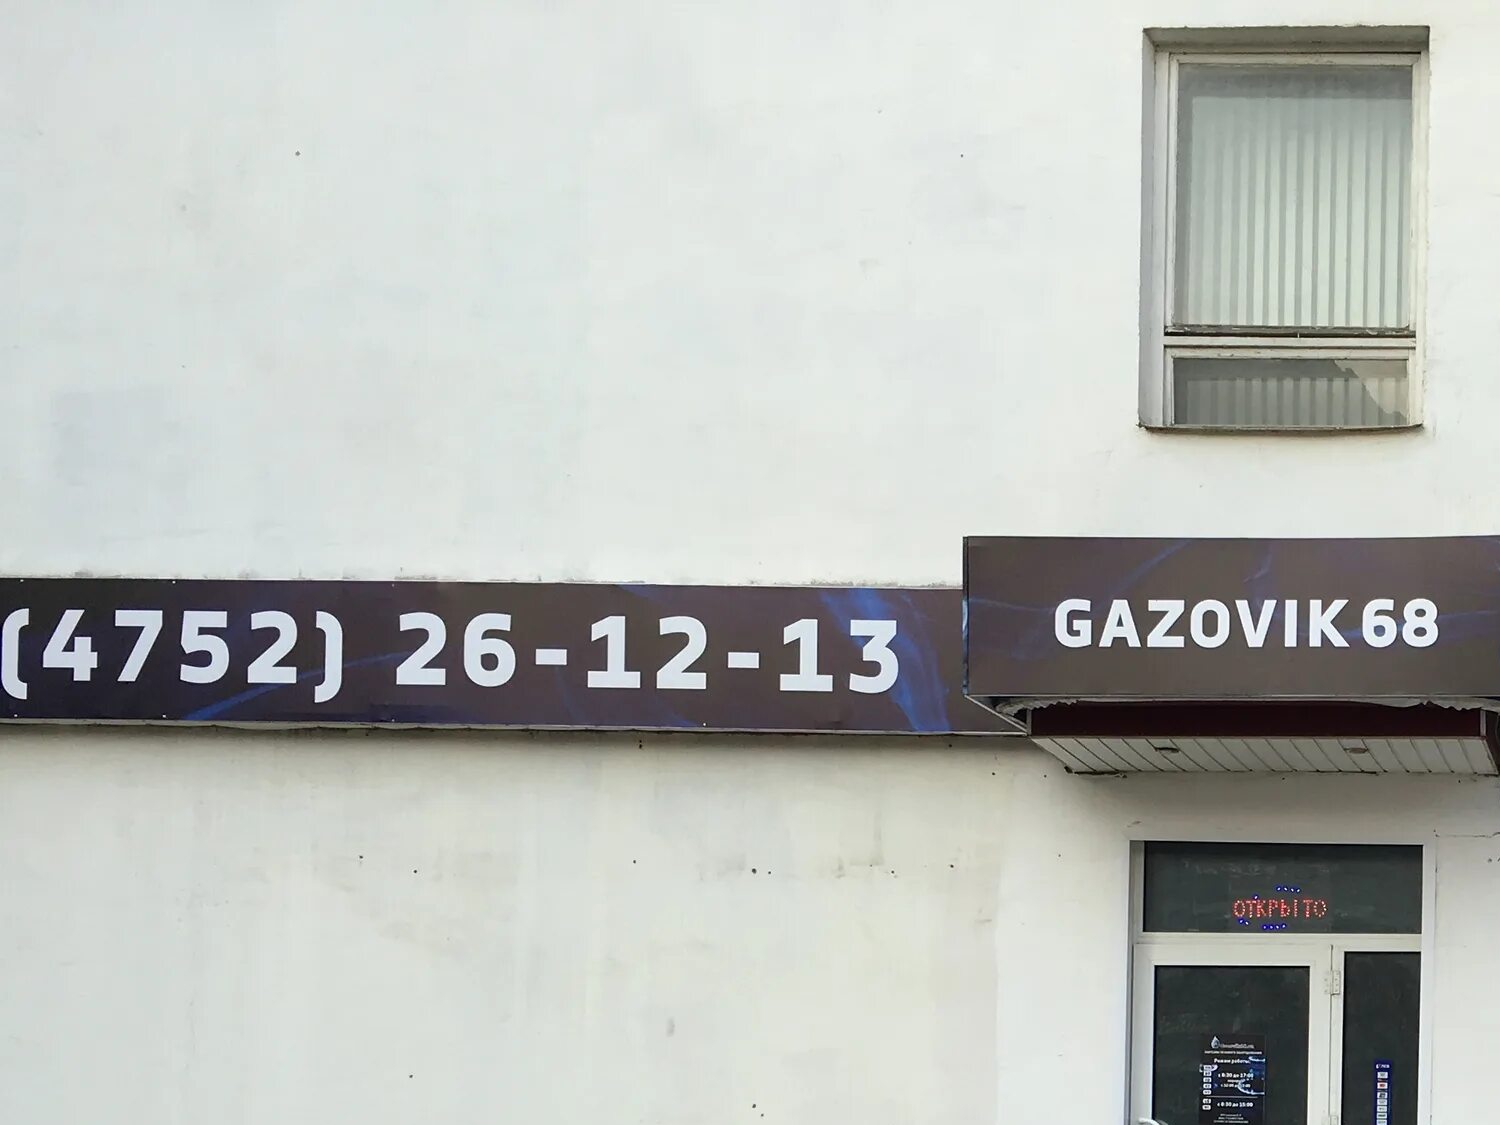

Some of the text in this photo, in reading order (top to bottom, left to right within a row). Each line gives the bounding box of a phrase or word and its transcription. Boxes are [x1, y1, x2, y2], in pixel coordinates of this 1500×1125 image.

[1, 608, 899, 703] (4752) 26-12-13
[1233, 899, 1327, 918] ОТКРЫТО
